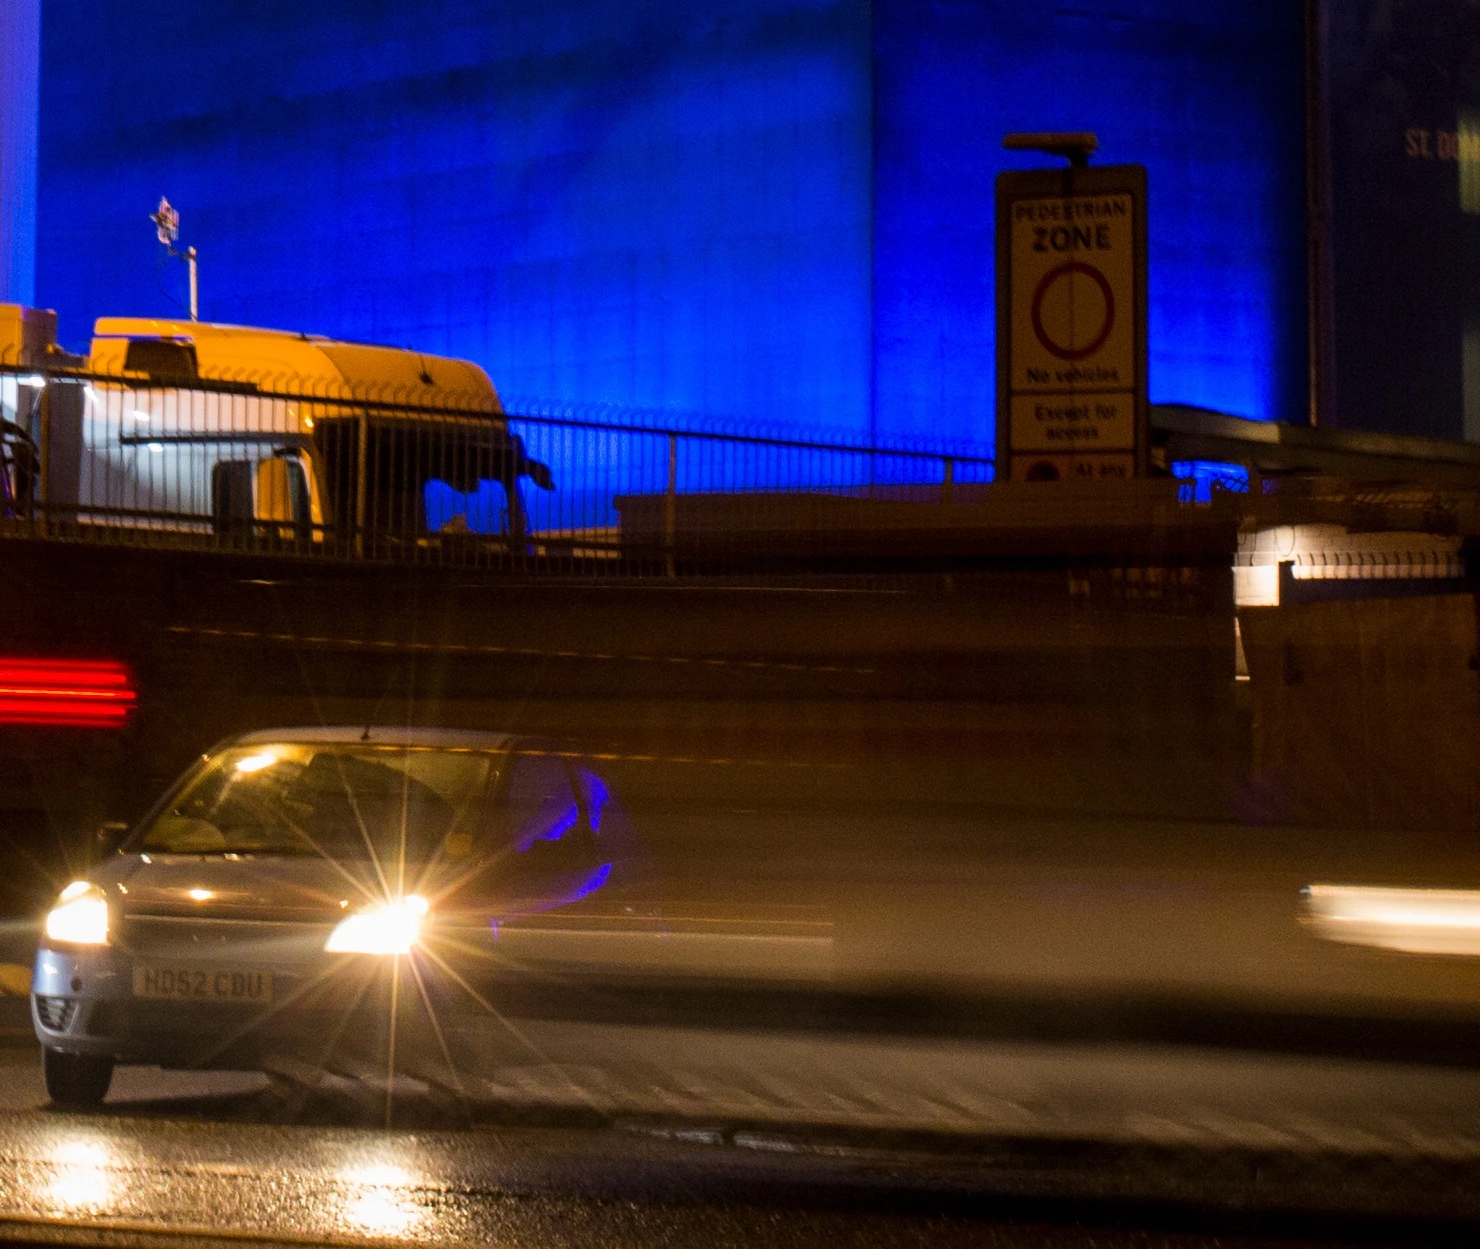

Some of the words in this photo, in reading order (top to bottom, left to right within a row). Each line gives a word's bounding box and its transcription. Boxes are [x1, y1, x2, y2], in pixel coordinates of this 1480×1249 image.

[1014, 199, 1126, 222] PEDESTRIAN
[1031, 223, 1112, 253] ZONE
[1027, 366, 1049, 383] No
[1054, 365, 1120, 383] vehicles
[1034, 404, 1091, 422] Except
